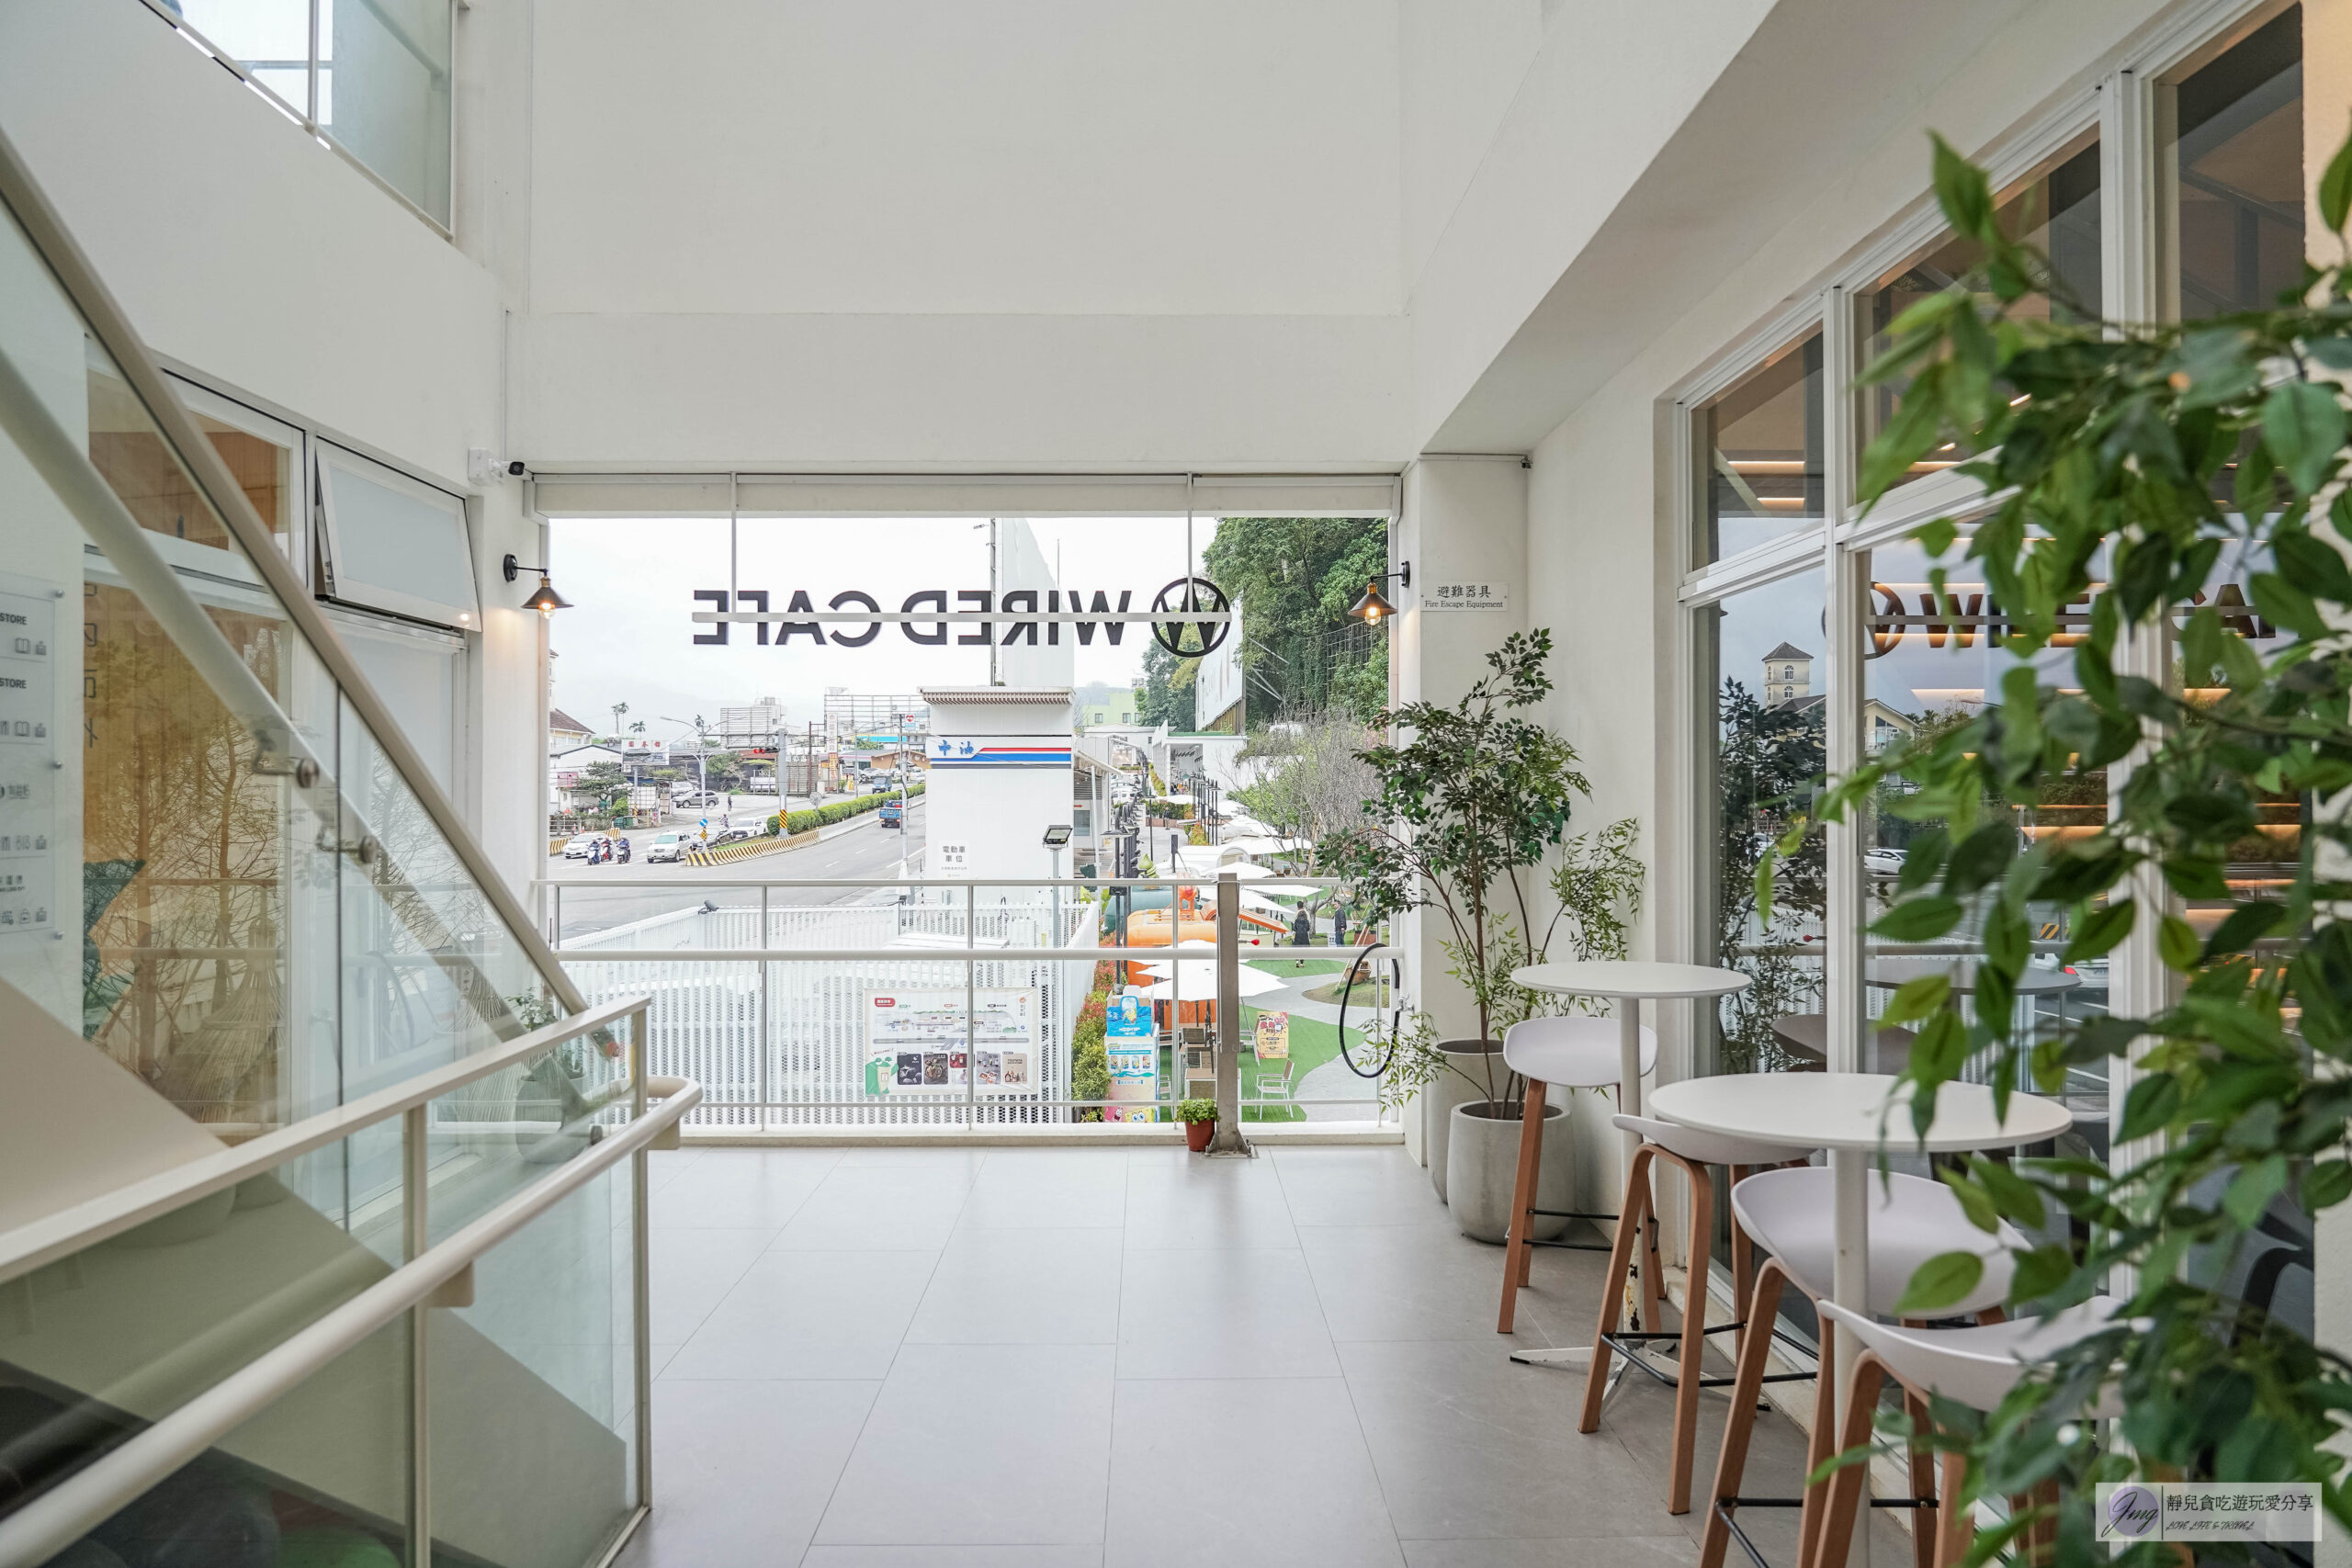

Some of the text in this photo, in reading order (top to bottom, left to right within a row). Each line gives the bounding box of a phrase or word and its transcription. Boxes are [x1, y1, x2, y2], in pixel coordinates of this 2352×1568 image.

[1437, 584, 1491, 598] 避難器具
[1425, 600, 1503, 609] Fire Escape Equipment
[938, 739, 974, 757] 中油
[943, 845, 966, 853] 電動車
